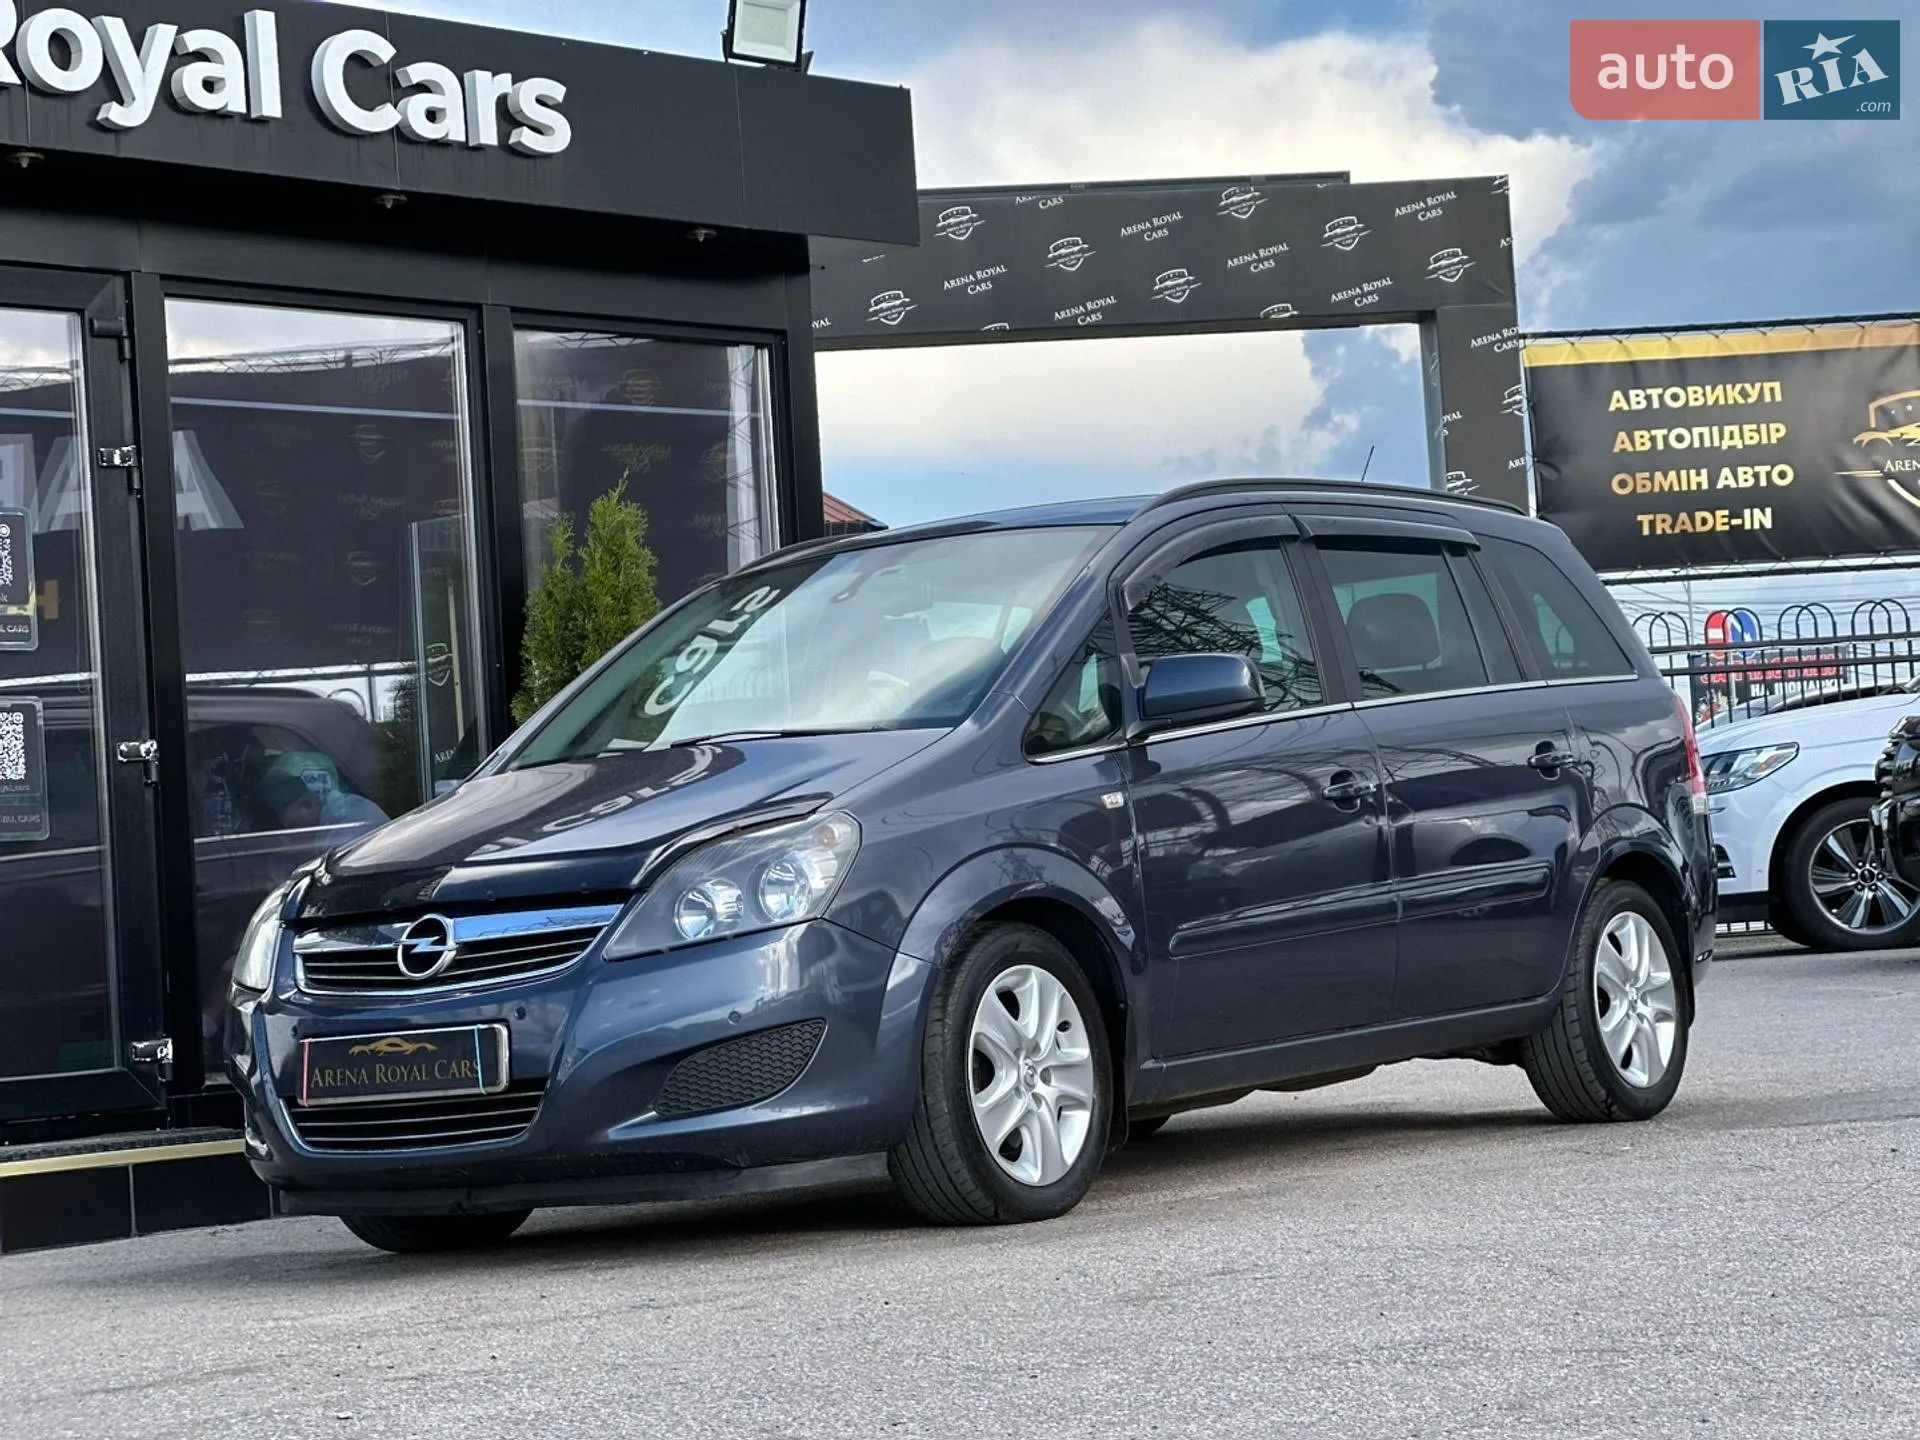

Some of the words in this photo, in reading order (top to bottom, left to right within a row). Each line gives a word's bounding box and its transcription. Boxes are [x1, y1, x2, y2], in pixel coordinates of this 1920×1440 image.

[310, 28, 572, 156] Cars
[1394, 200, 1427, 217] ARENA
[1426, 189, 1458, 208] ROYAL
[1417, 206, 1444, 222] CARS
[1120, 220, 1152, 237] ARENA
[1152, 210, 1184, 228] ROYAL
[1143, 227, 1169, 242] CARS
[1226, 251, 1259, 269] ARENA
[1259, 242, 1290, 260] ROYAL
[1249, 258, 1276, 273] CARS
[943, 271, 976, 291] ARENA
[976, 263, 1008, 282] ROYAL
[967, 280, 993, 296] CARS
[1330, 286, 1363, 304] ARENA
[1363, 276, 1394, 294] ROYAL
[1053, 302, 1086, 322] ARENA
[1086, 295, 1118, 314] ROYAL
[1354, 293, 1380, 308] CARS
[1077, 312, 1103, 327] CARS
[1470, 332, 1502, 349] ARENA
[1493, 338, 1520, 353] CARS
[1608, 380, 1783, 412] АВТОВИКУП
[1612, 422, 1787, 453] АВТОПІДБІР
[1611, 467, 1709, 496] ОБМІН
[1715, 463, 1795, 490] АВТО
[1636, 508, 1773, 536] TRADE-IN
[310, 1066, 369, 1088] ARENA
[375, 1062, 430, 1085] ROYAL
[434, 1058, 481, 1080] CARS
